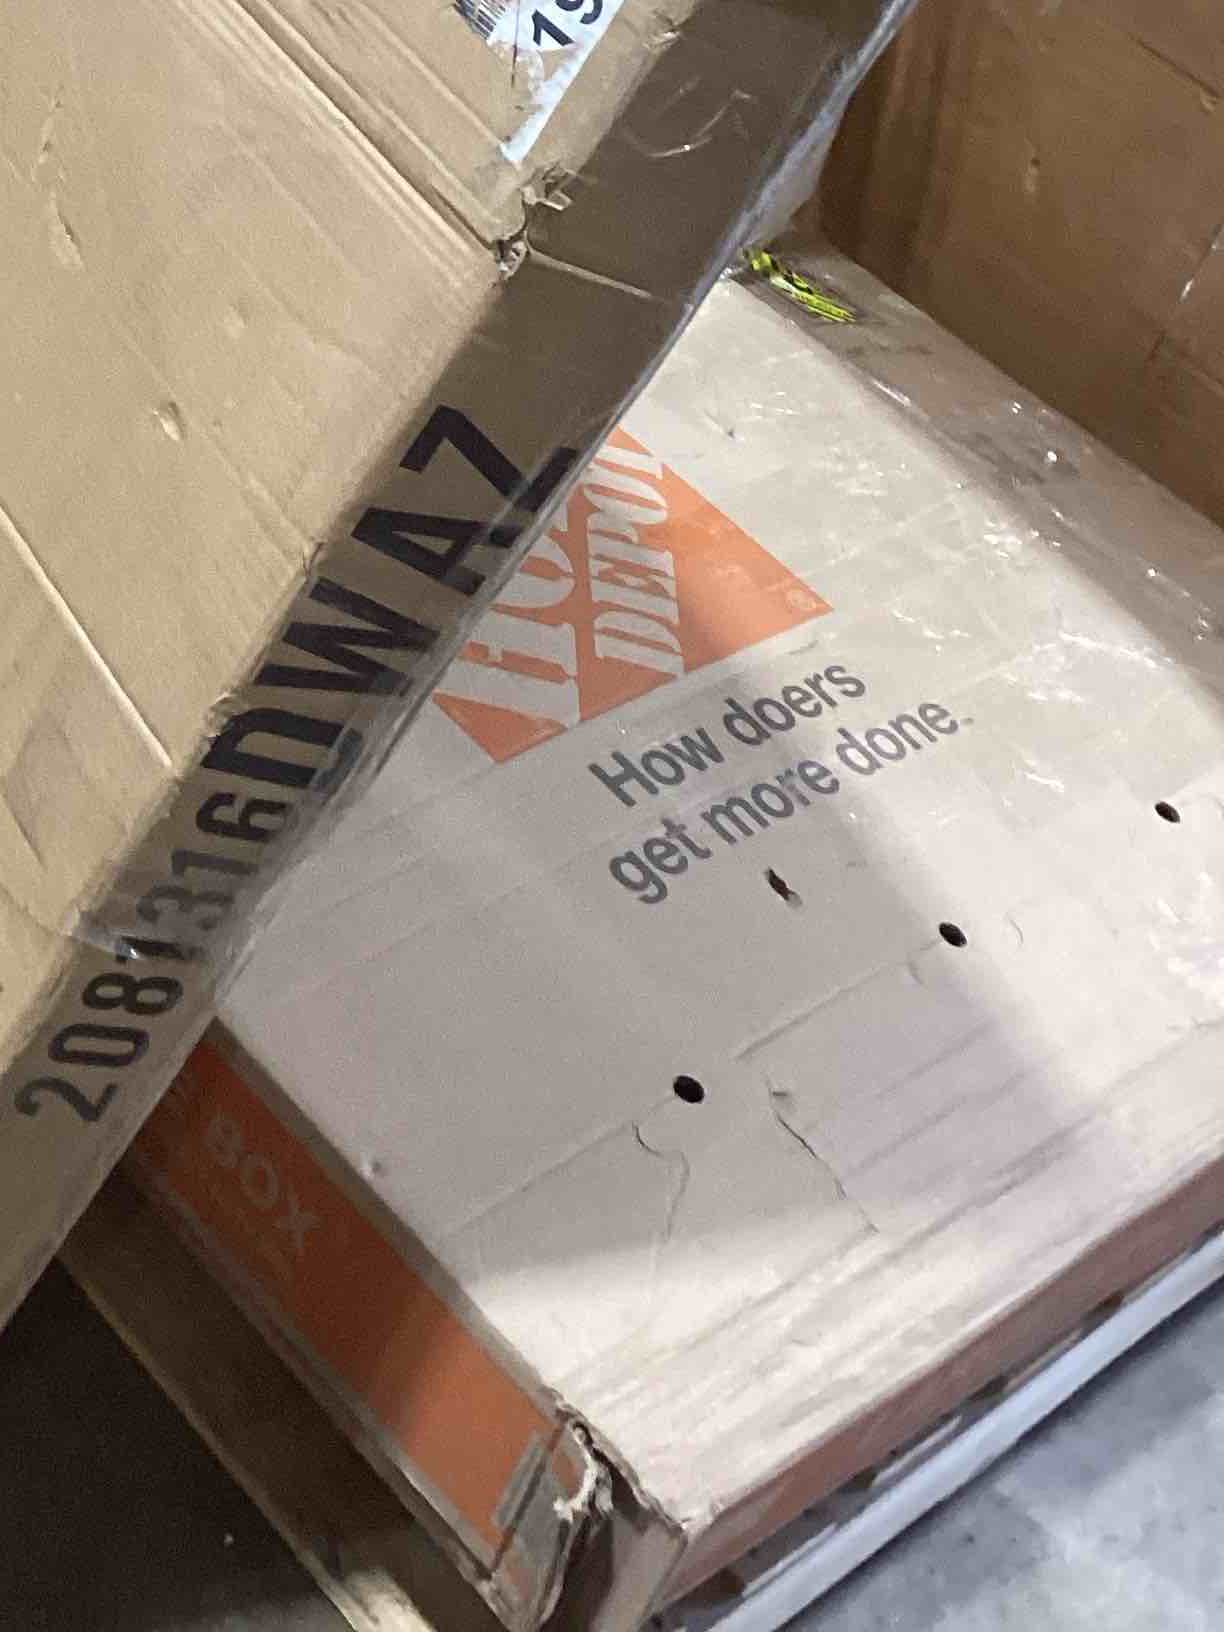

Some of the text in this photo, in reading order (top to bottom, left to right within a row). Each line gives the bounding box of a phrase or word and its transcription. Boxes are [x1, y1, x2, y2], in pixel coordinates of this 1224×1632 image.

[13, 404, 580, 1124] 2081316DWAZ
[588, 664, 867, 808] How doers
[608, 818, 713, 906] get
[701, 758, 841, 846] more
